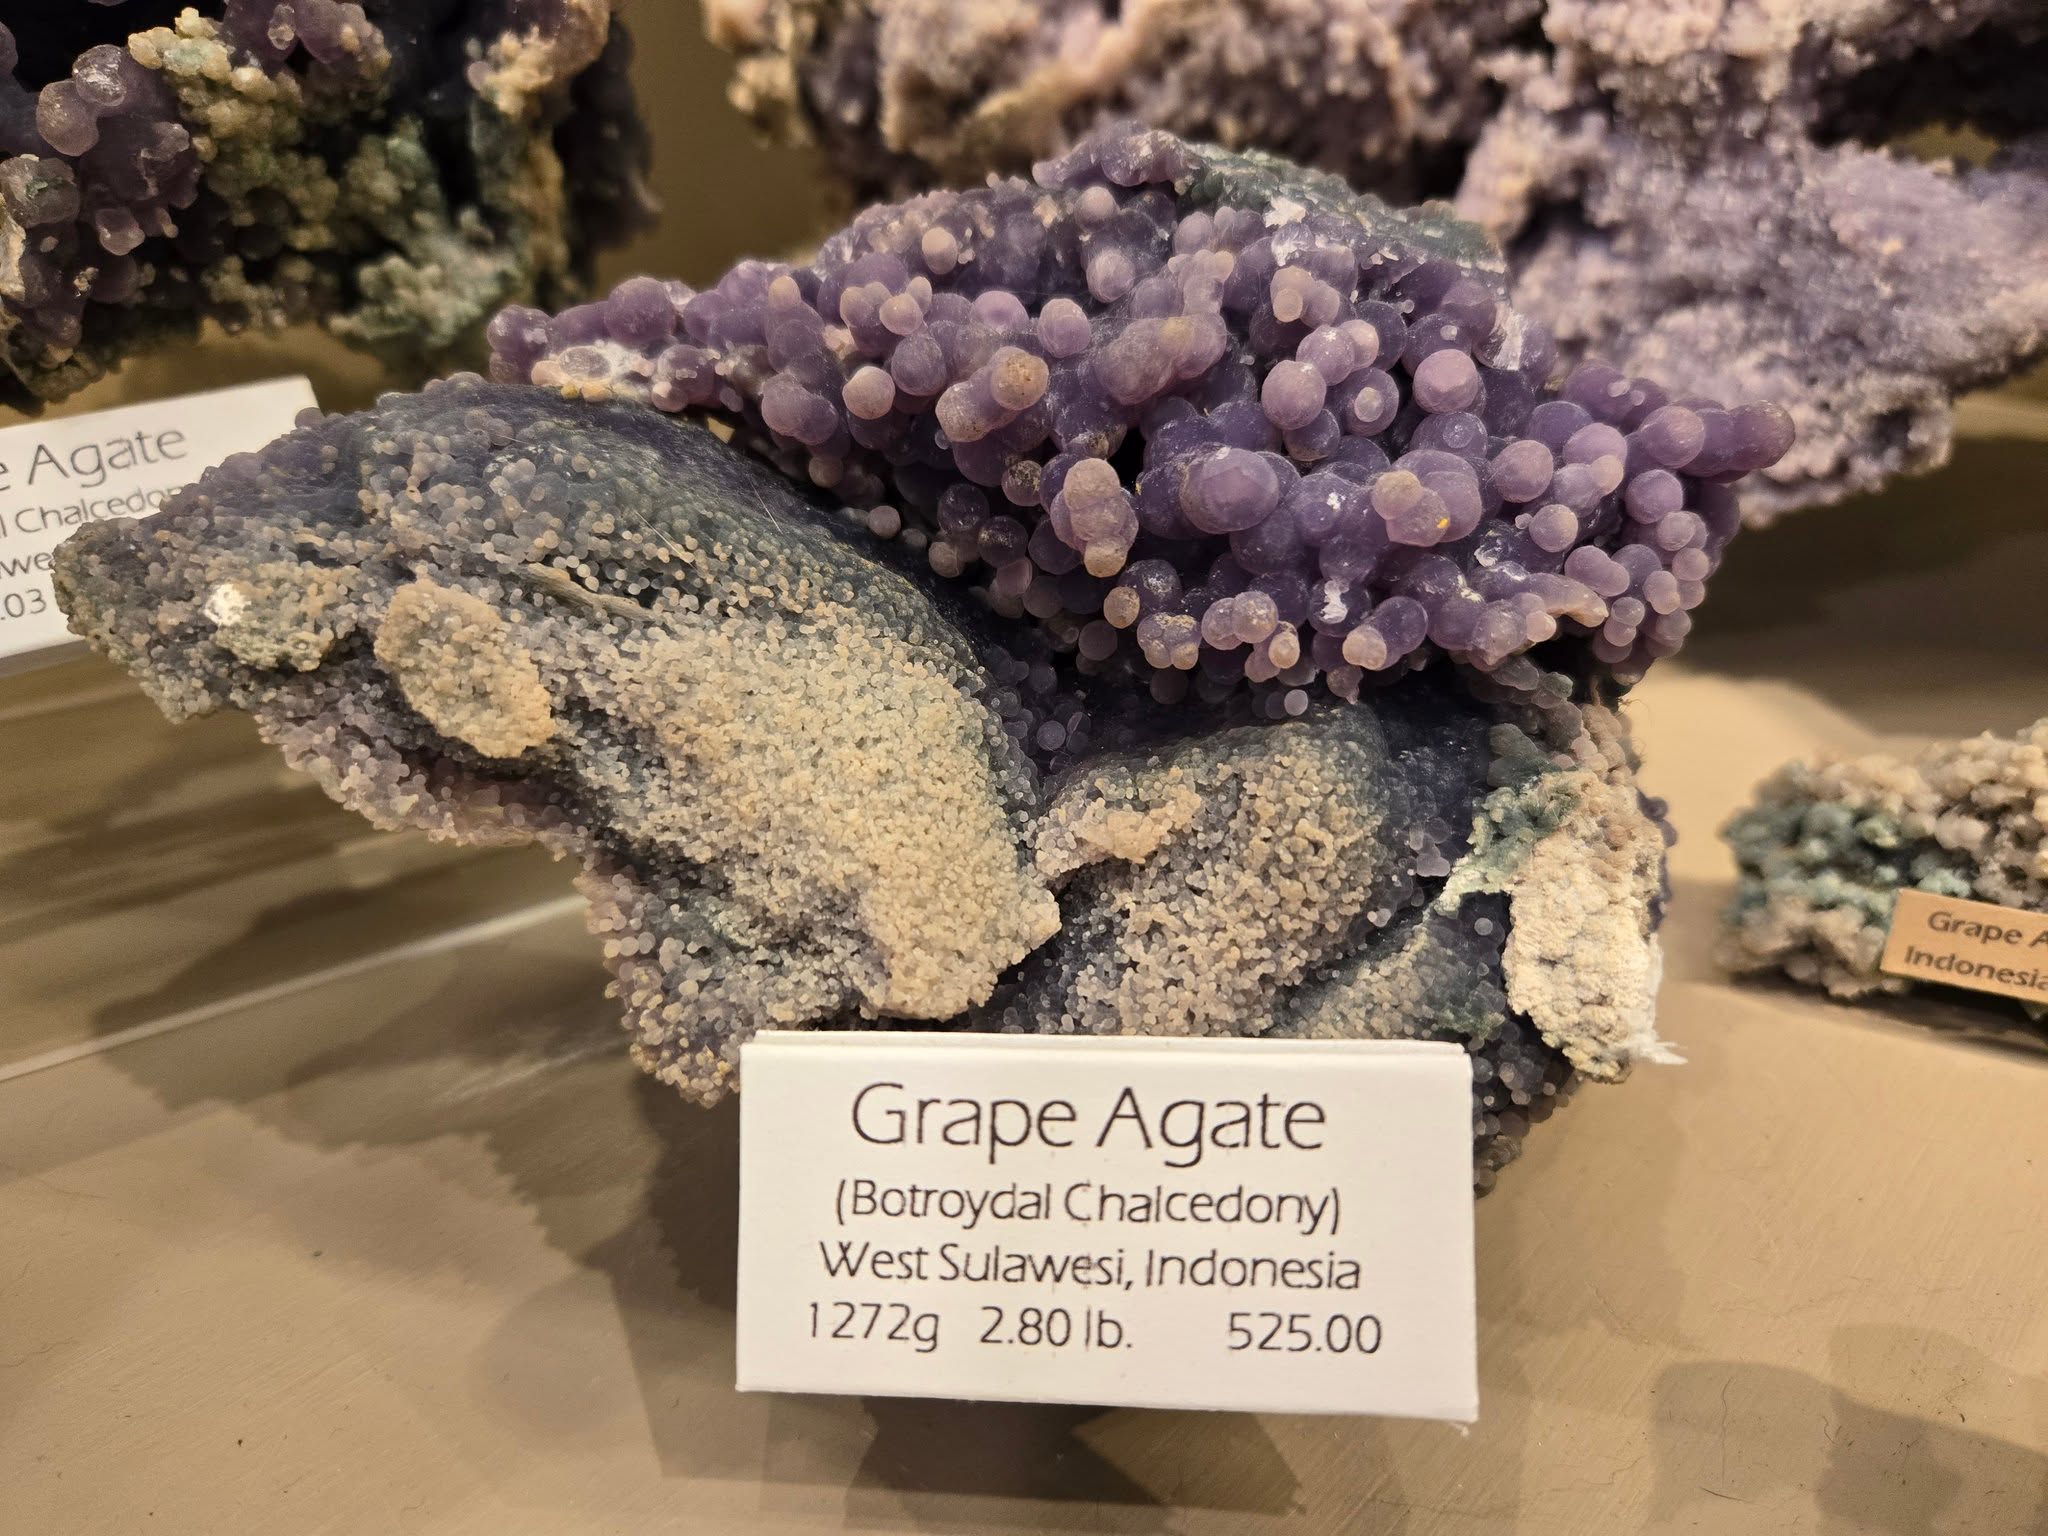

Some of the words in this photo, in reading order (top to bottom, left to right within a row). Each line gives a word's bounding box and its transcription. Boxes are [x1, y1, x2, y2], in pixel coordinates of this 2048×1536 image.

[27, 429, 188, 488] Agate
[1927, 911, 2023, 945] Grape
[1903, 945, 2048, 991] Indonesia
[851, 1081, 1077, 1165] Grape
[1096, 1086, 1327, 1168] Agate
[835, 1179, 1052, 1230] (Botroydal
[1064, 1181, 1341, 1236] Chalcedony)
[818, 1240, 929, 1282] West
[938, 1242, 1134, 1292] Sulawesi,
[1144, 1247, 1362, 1290] Indonesia
[808, 1301, 939, 1353] 1272g
[979, 1305, 1071, 1348] 2.80
[1084, 1307, 1133, 1350] lb.
[1227, 1311, 1383, 1355] 525.00
